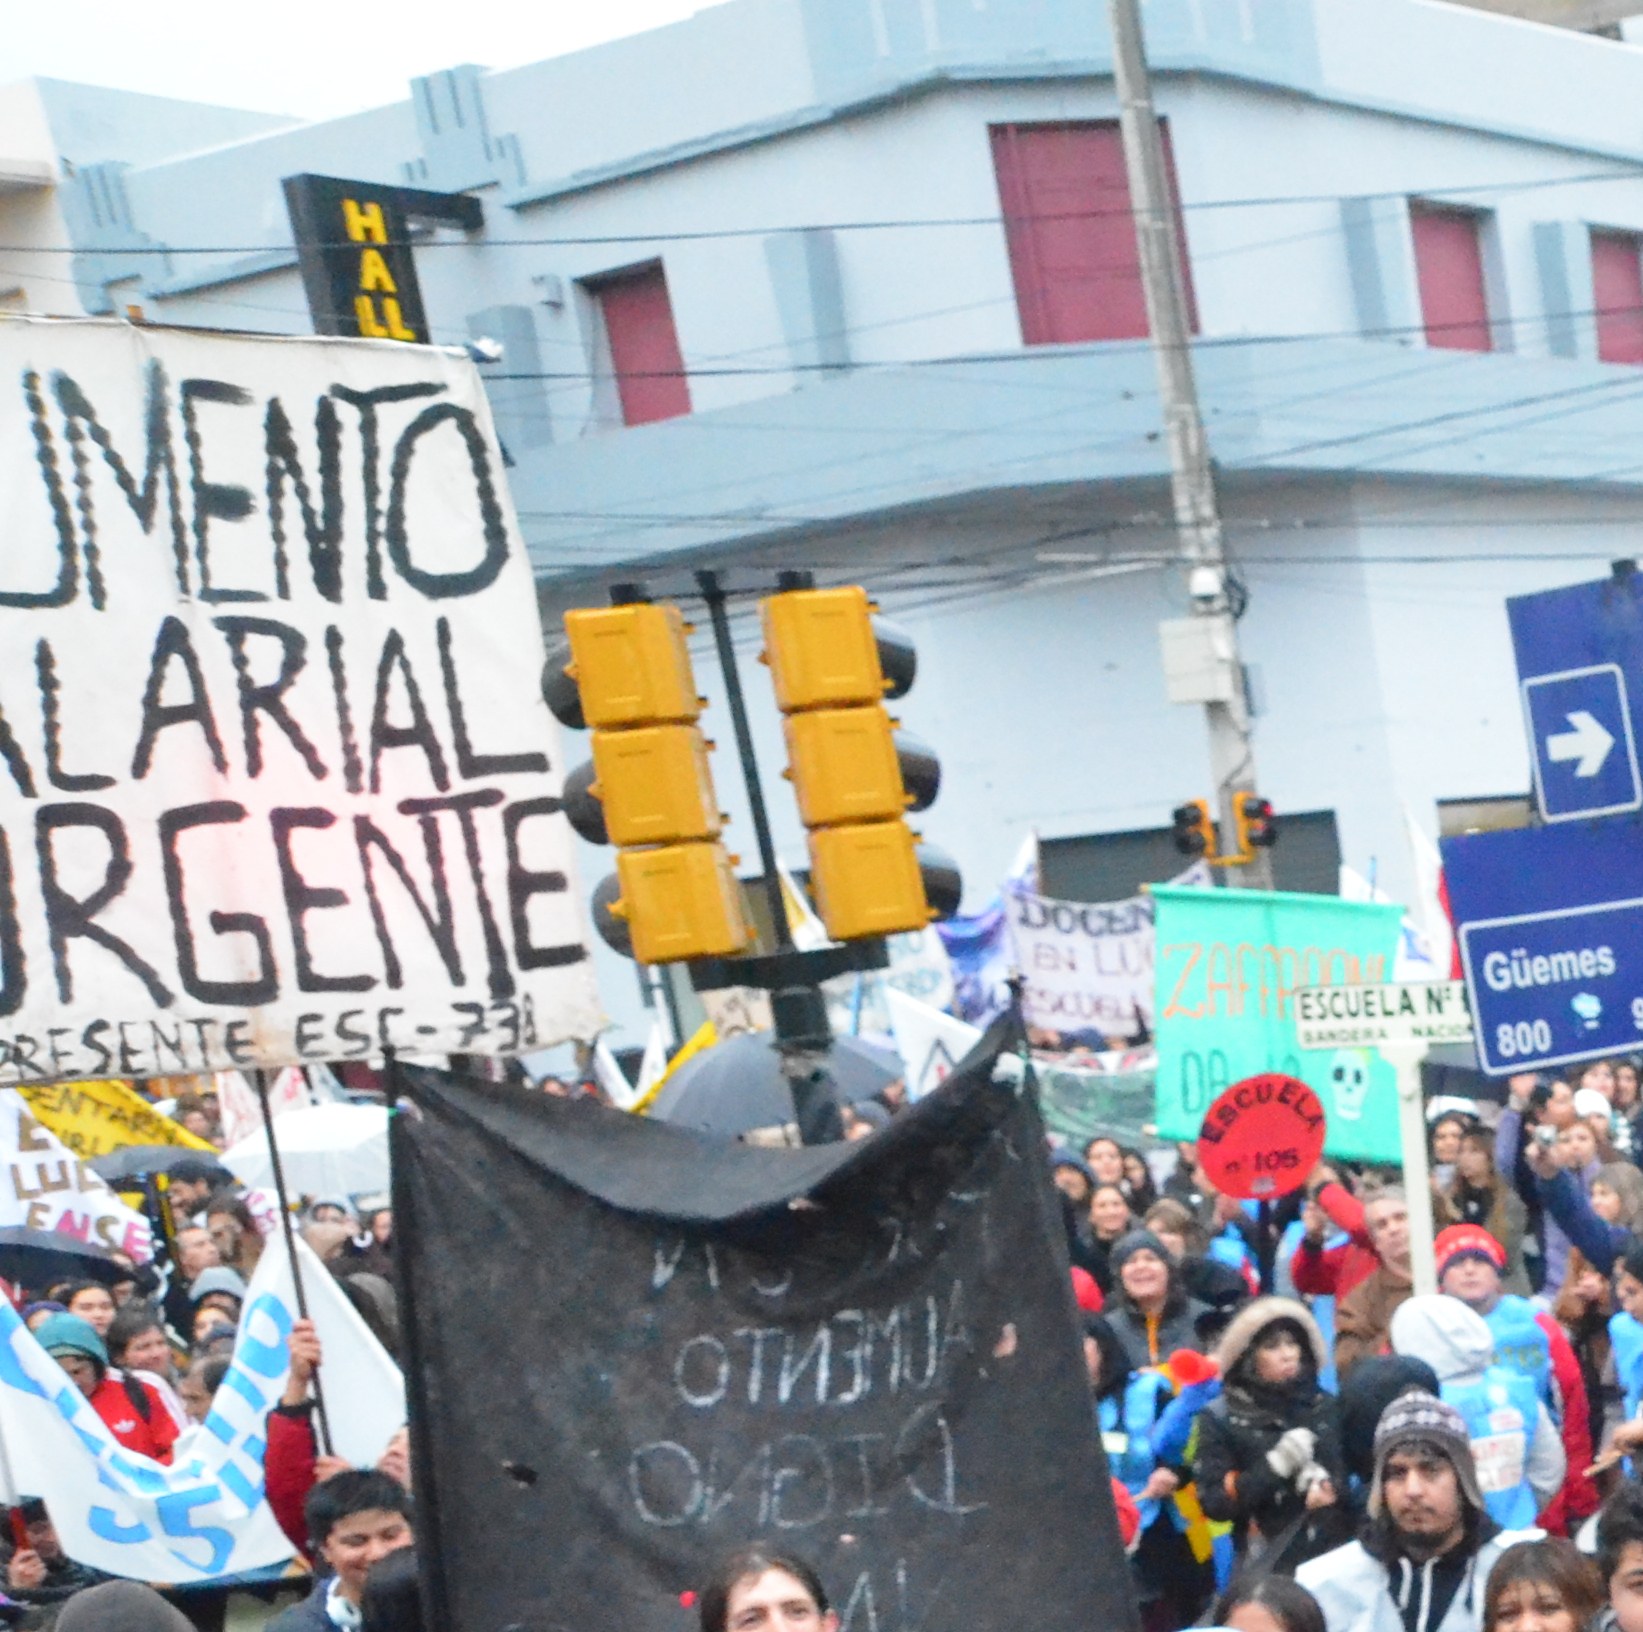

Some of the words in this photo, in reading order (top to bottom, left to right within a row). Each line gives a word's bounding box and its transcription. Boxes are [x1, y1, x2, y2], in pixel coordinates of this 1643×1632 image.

[343, 198, 417, 342] HALL
[1482, 943, 1616, 992] Güemes
[1301, 982, 1417, 1021] ESCUELA
[1496, 1020, 1552, 1060] 800
